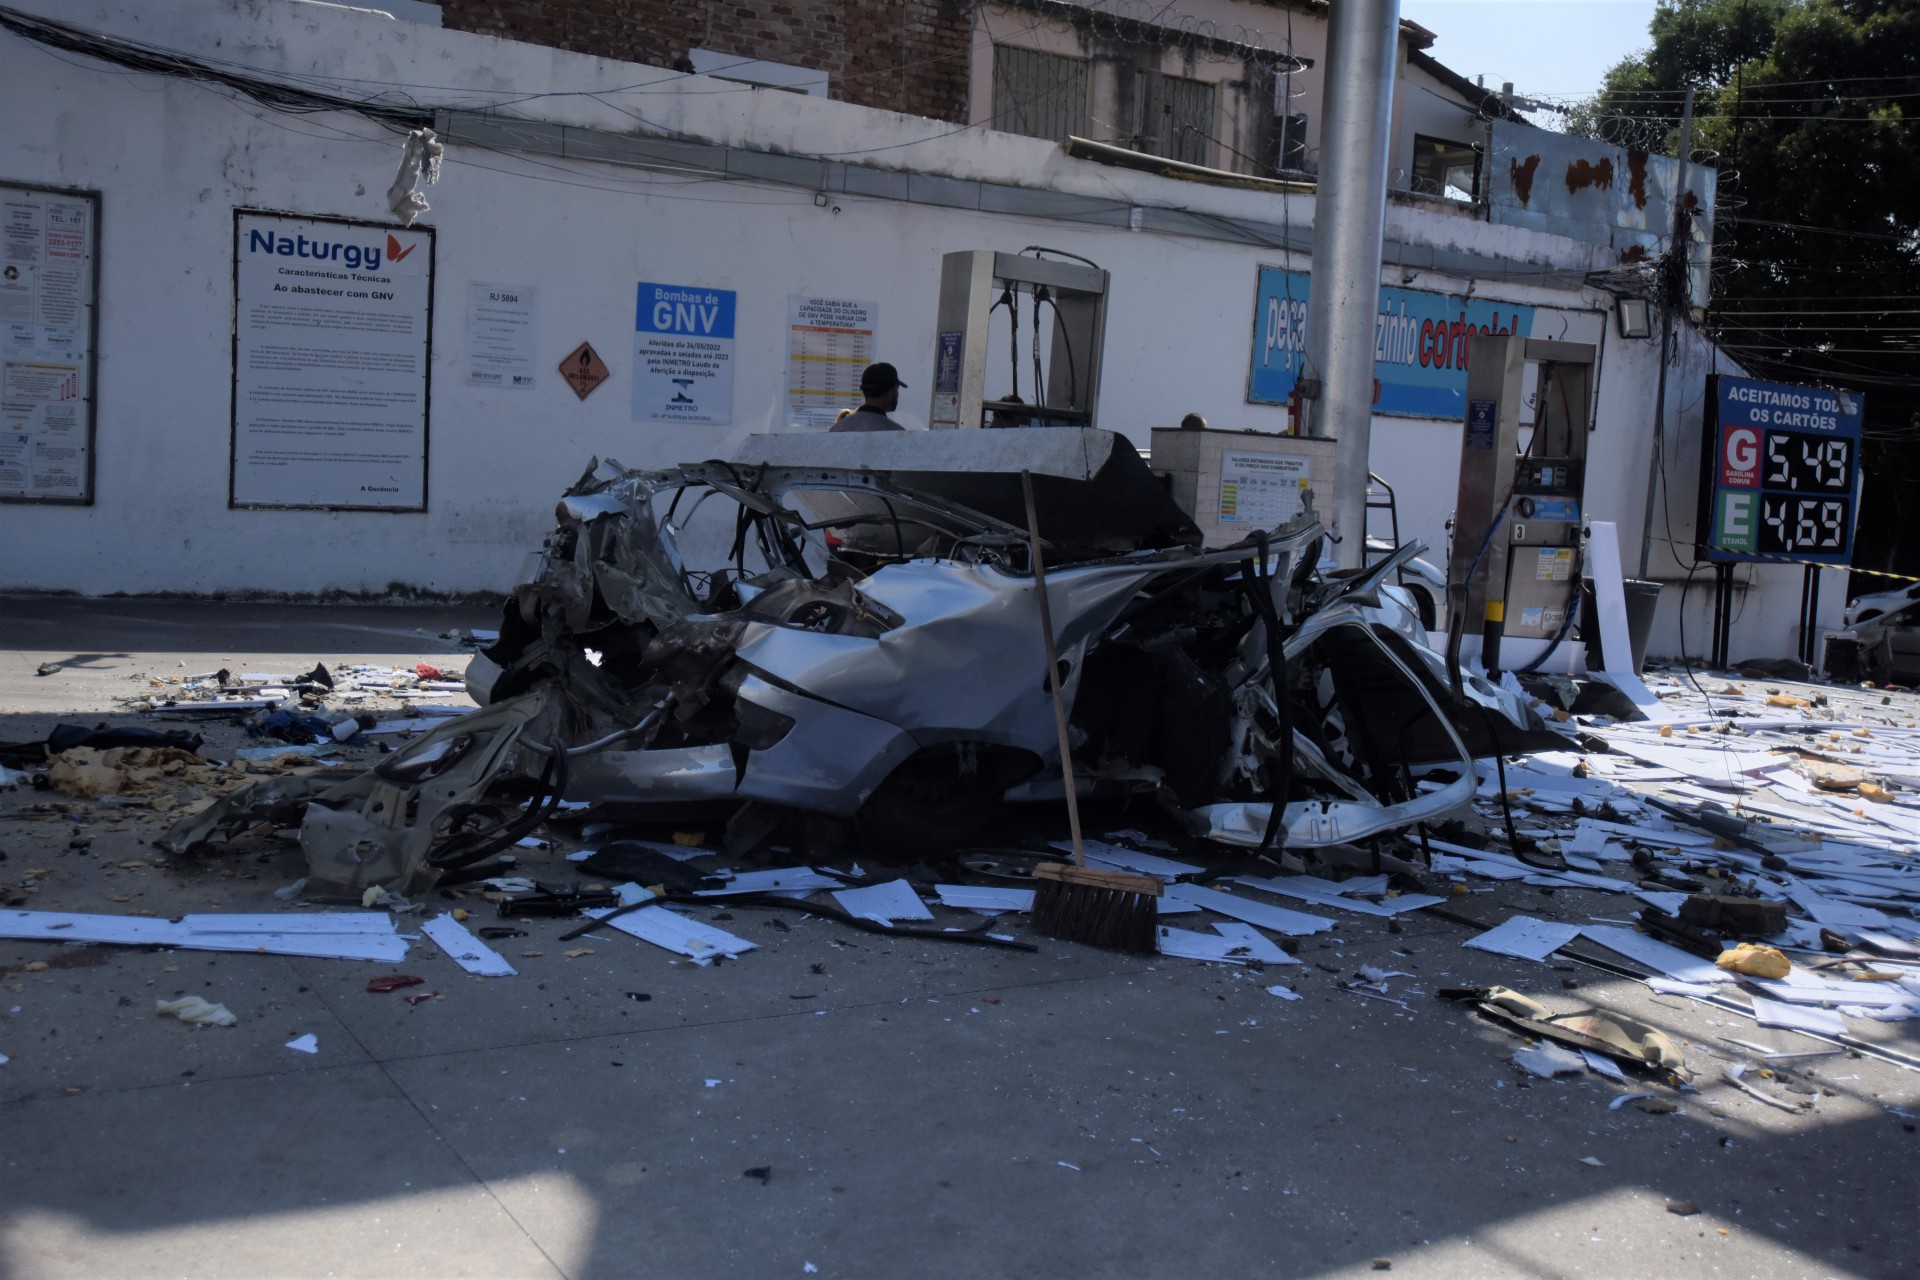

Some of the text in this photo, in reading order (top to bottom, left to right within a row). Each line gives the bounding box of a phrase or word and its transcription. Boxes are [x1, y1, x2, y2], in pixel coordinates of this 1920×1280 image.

[250, 228, 382, 271] Naturgy
[352, 272, 392, 283] Técnicas
[273, 284, 394, 300] Ao abastecer com GNV
[490, 293, 500, 302] RJ
[655, 288, 719, 305] Bombas de
[653, 302, 719, 333] GNV
[1264, 296, 1307, 370] peça
[639, 348, 671, 356] aprovadas
[648, 340, 674, 348] Aferidas
[650, 367, 676, 375] Aferição
[580, 381, 587, 392] 2
[1728, 387, 1858, 415] ACEITAMOS TODS
[1750, 408, 1836, 430] OS CARTÕES
[1726, 429, 1757, 471] G
[1768, 435, 1848, 490] 5,49
[1725, 470, 1754, 478] GASOLINA
[1724, 494, 1750, 535] E
[1516, 526, 1522, 539] 3
[1764, 500, 1843, 552] 4,69
